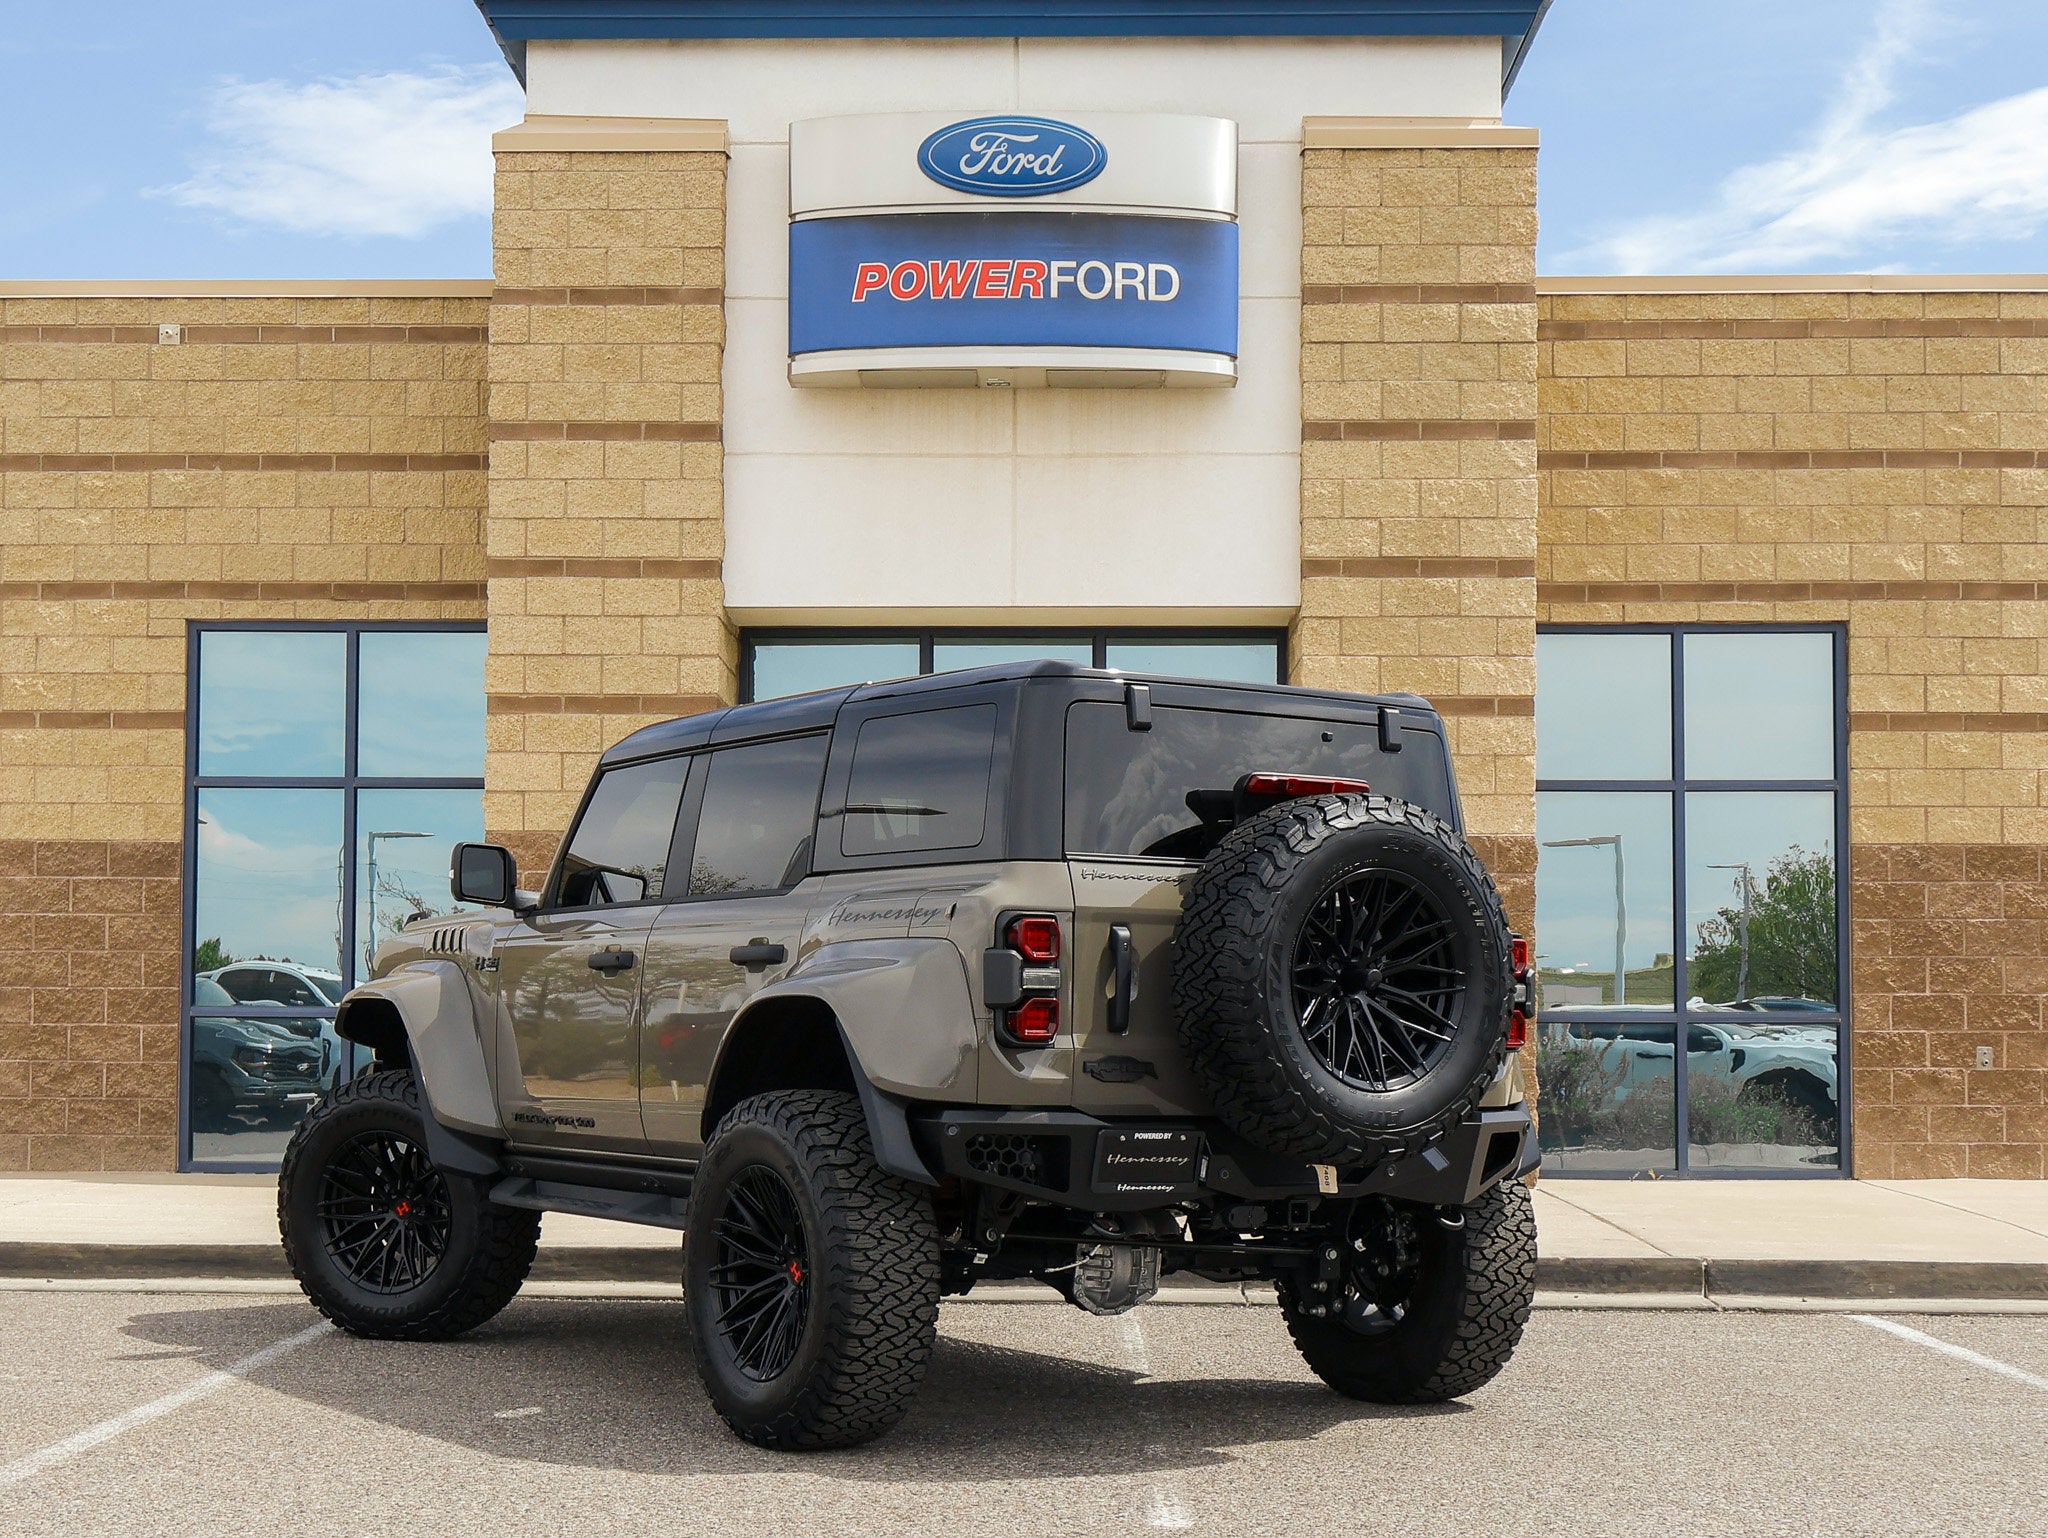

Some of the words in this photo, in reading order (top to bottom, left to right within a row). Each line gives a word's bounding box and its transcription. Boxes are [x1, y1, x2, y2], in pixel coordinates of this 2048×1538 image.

[959, 131, 1065, 177] Ford
[1081, 867, 1188, 887] Hennessey
[828, 907, 941, 926] Hennessey
[1164, 1132, 1173, 1140] BY
[1107, 1154, 1189, 1166] Hennessey
[1117, 1184, 1176, 1193] Hennessey
